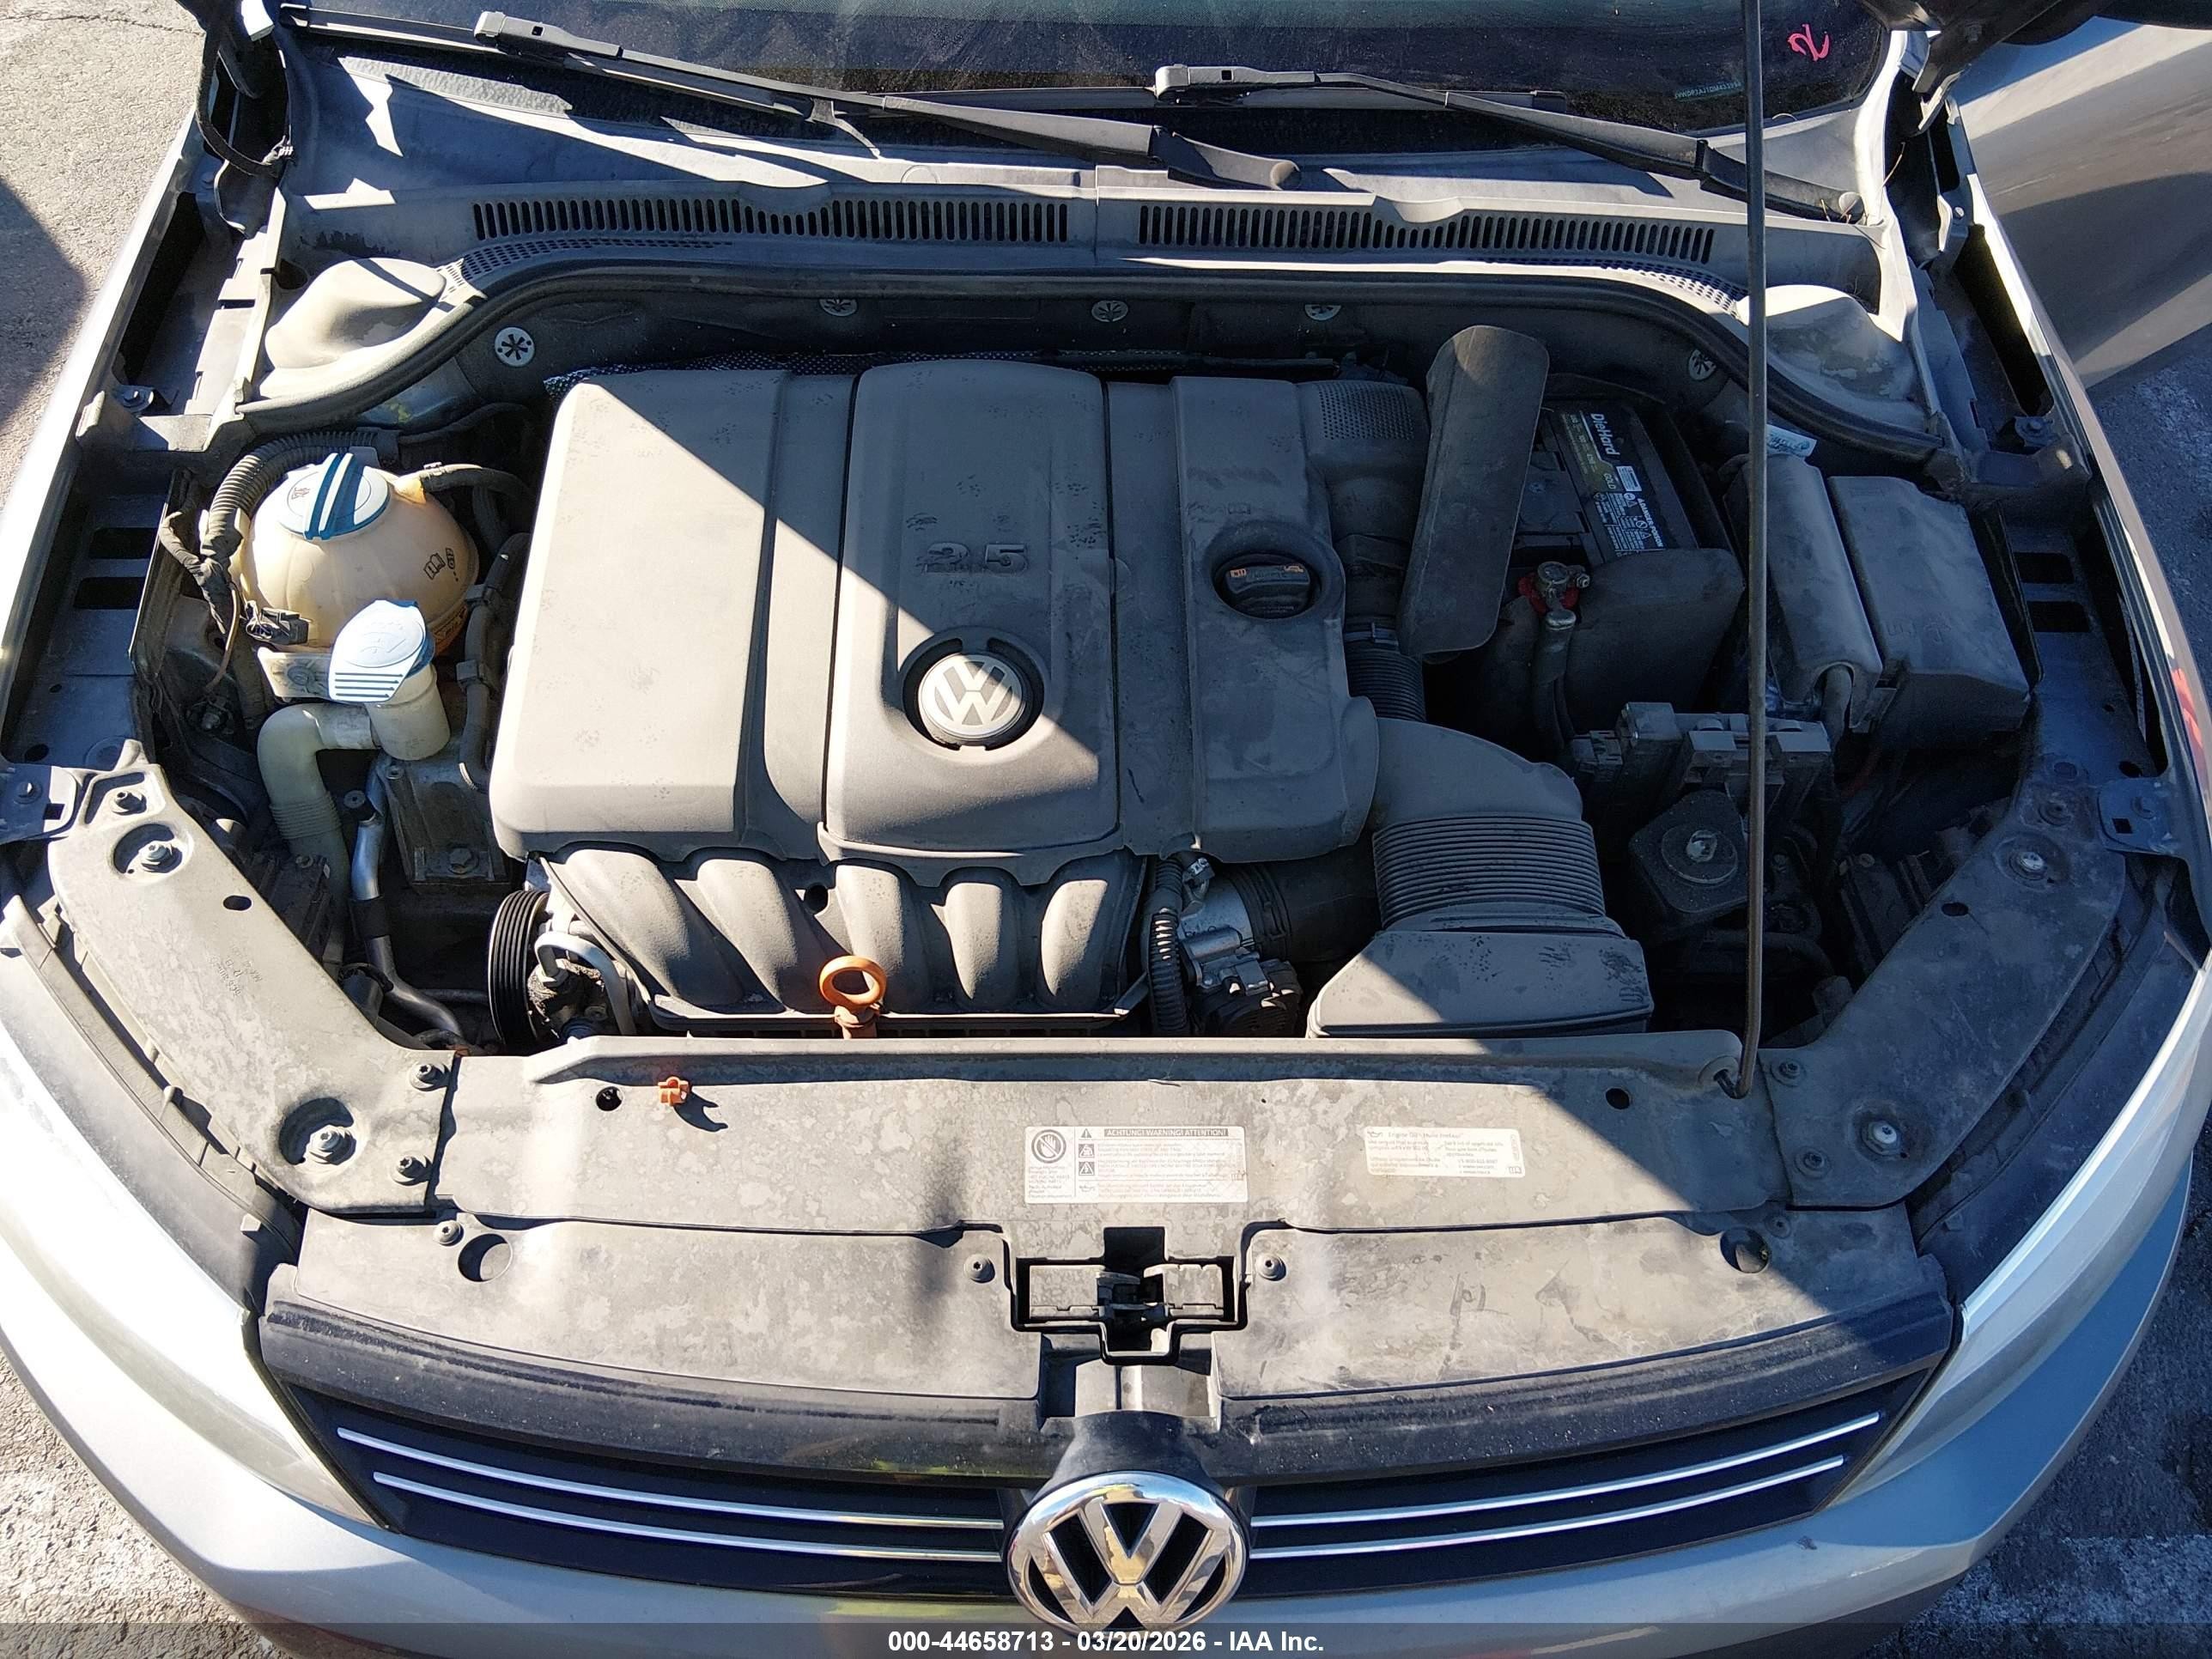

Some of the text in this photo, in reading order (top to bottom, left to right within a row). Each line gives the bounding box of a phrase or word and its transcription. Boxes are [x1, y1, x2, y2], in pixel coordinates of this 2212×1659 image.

[1590, 413, 1620, 456] DieHard
[1603, 473, 1616, 489] GOLD
[1106, 1128, 1226, 1137] ACHTUNG! WARNING! ATTENTION!
